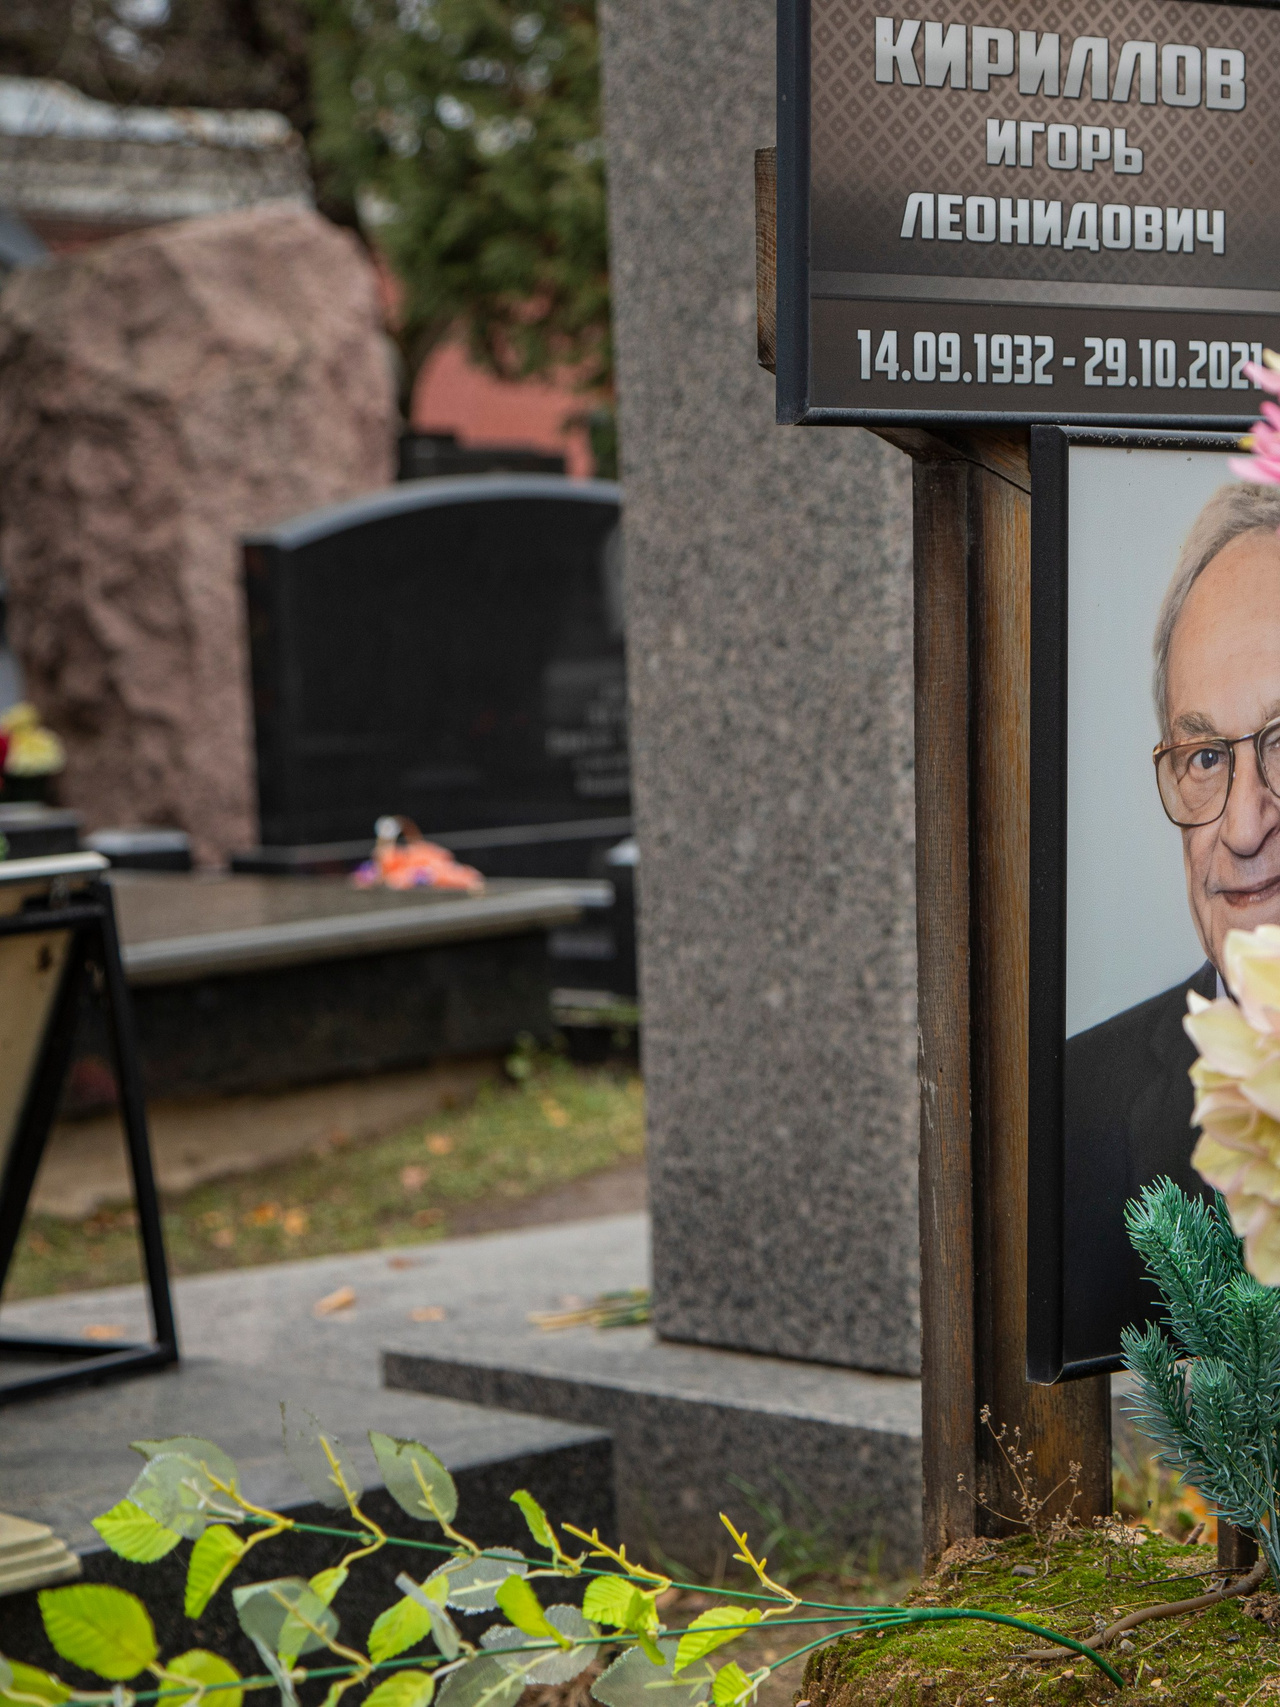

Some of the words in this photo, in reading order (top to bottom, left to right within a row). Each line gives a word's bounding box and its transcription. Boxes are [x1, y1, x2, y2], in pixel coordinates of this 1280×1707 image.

[874, 16, 1246, 111] КИРИЛЛОВ
[985, 118, 1144, 174] ИГОРЬ
[900, 192, 1226, 255] ЛЕОНИДОВИЧ
